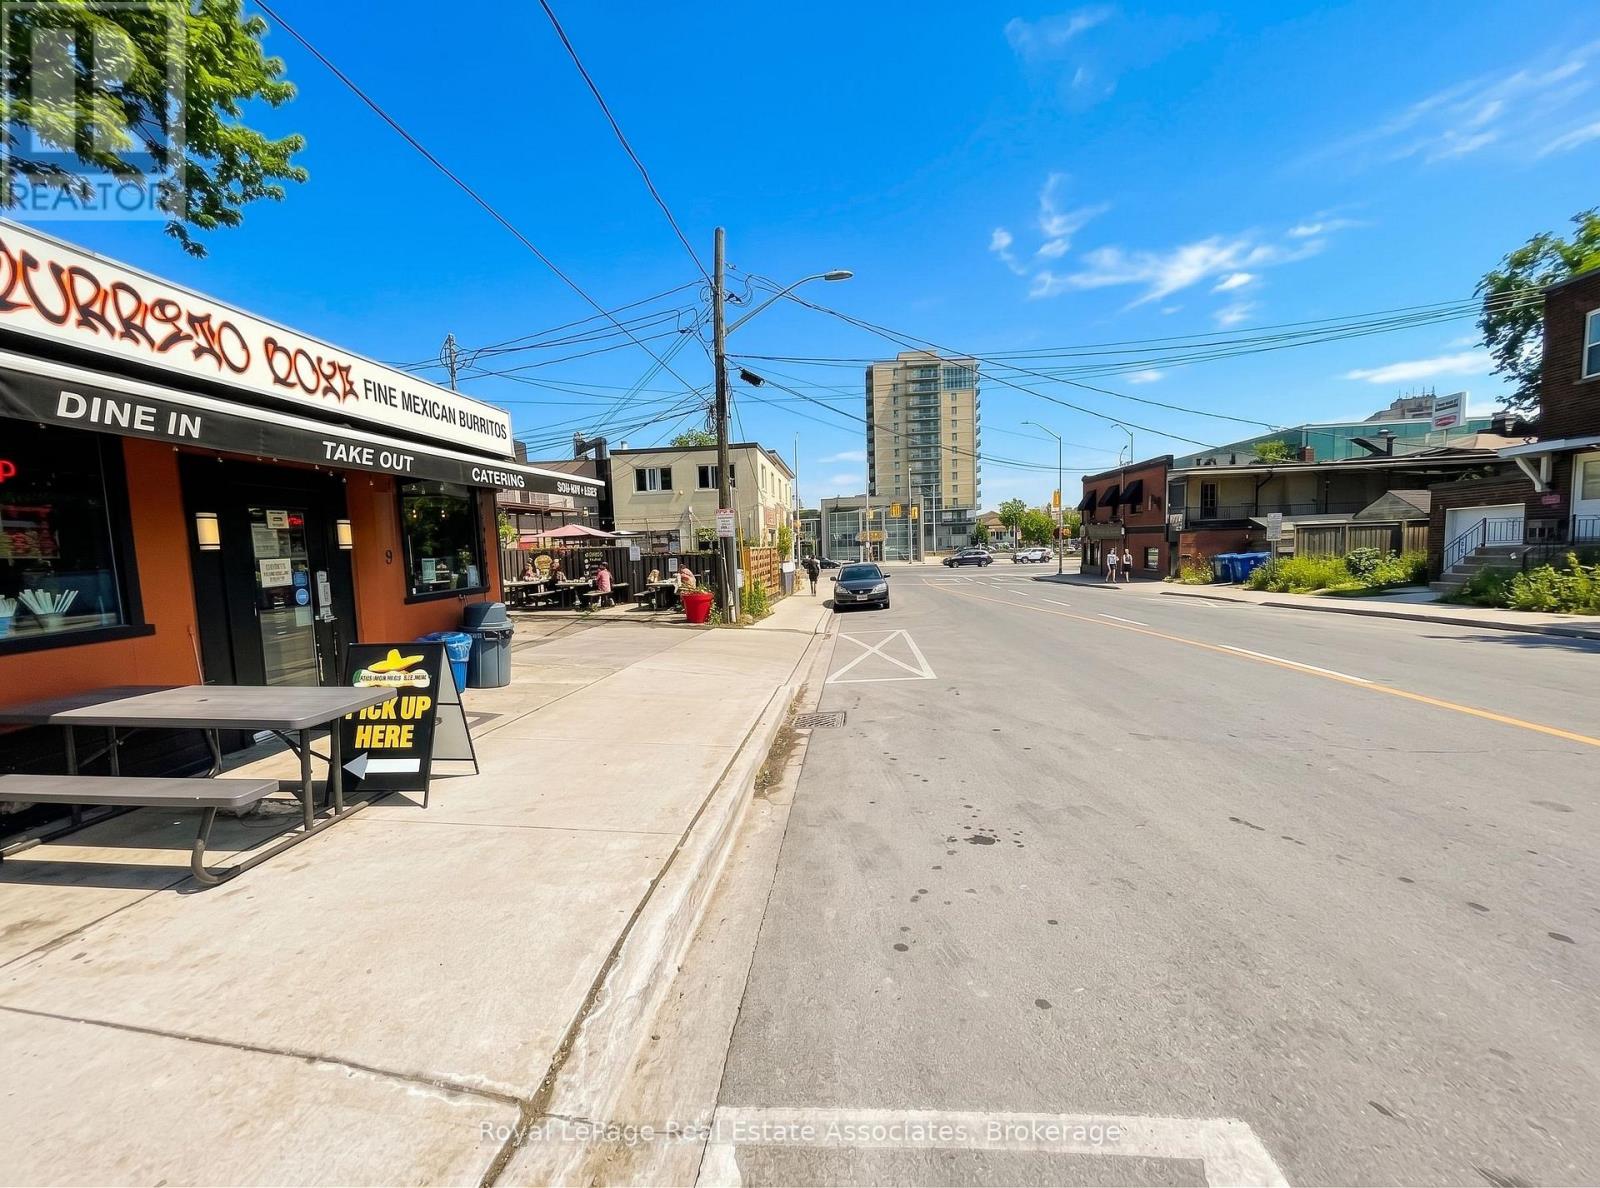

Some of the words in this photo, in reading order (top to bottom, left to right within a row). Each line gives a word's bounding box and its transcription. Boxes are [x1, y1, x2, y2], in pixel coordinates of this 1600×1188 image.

[56, 390, 157, 432] DINE
[167, 411, 202, 439] IN
[363, 378, 398, 408] FINE
[401, 391, 457, 425] MEXICAN
[459, 410, 507, 440] BURRITOS
[322, 441, 375, 466] TAKE
[379, 451, 414, 472] OUT
[471, 467, 525, 488] CATERING
[385, 549, 393, 565] 9
[400, 695, 432, 720] UP
[355, 724, 415, 749] HERE
